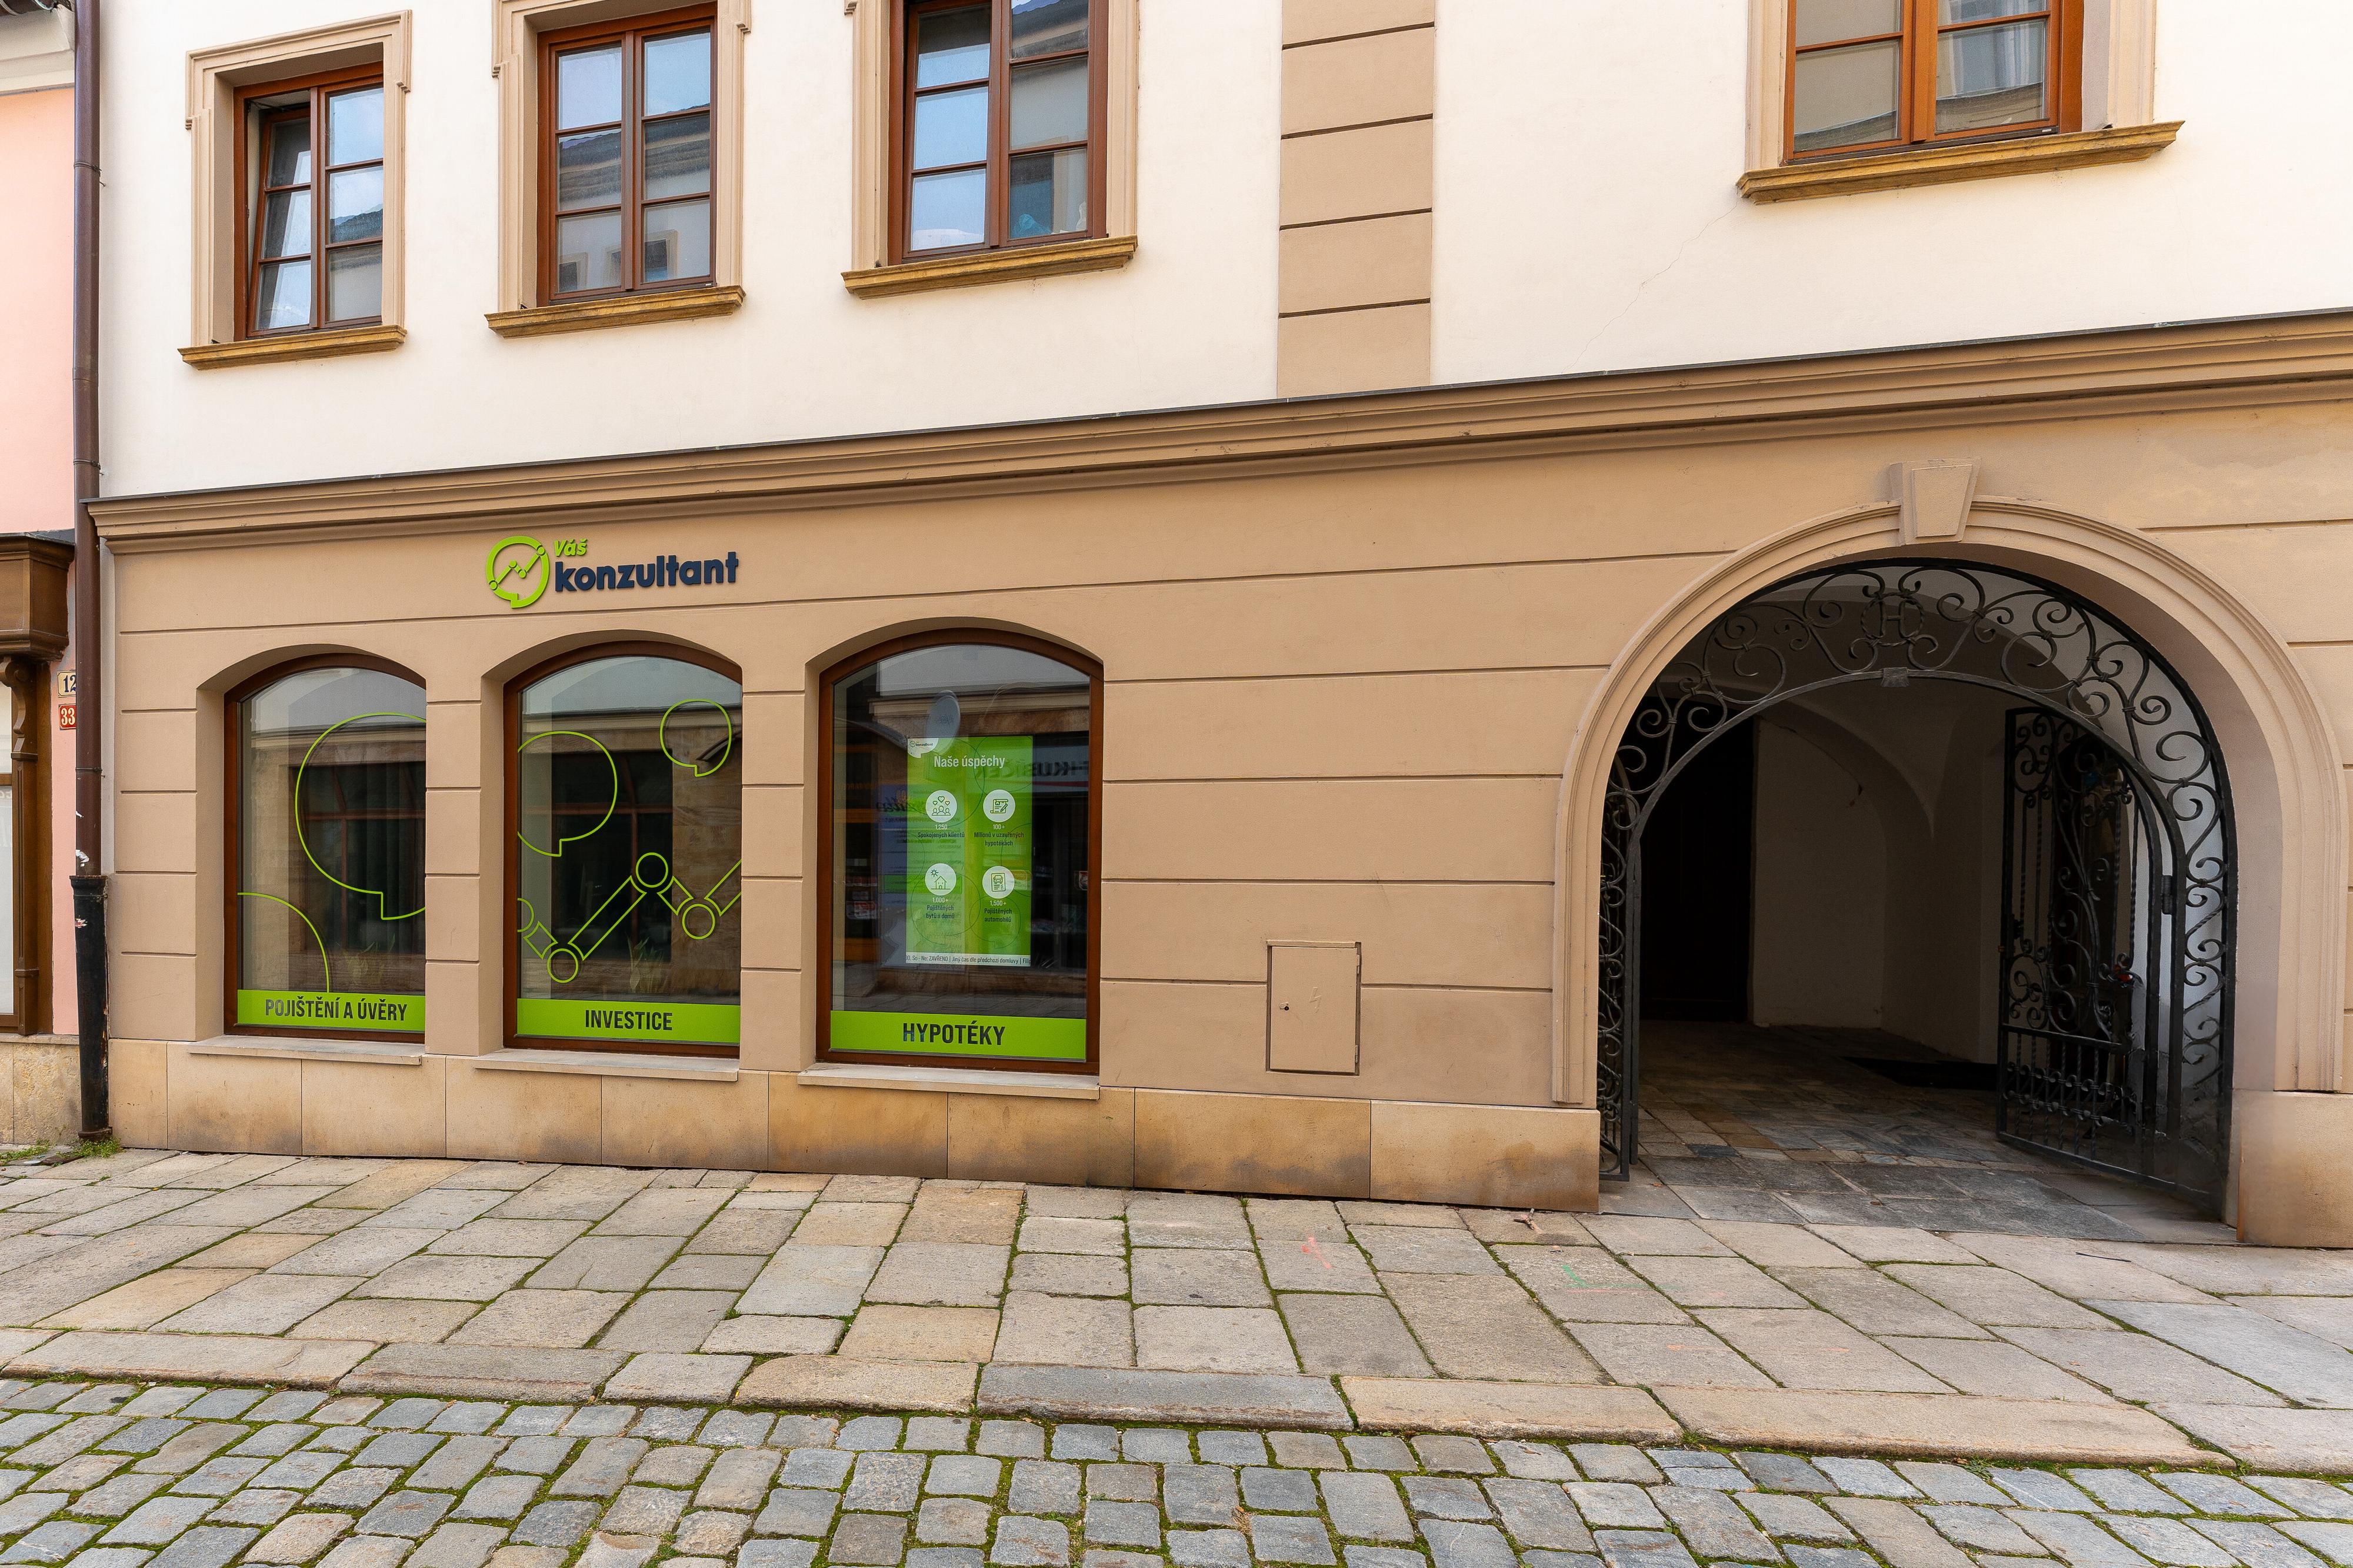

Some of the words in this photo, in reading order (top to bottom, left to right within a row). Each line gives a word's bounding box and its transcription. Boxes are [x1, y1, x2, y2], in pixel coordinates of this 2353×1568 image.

[554, 538, 588, 556] Váš
[555, 551, 739, 592] konzultant
[934, 755, 959, 768] Naše
[962, 755, 1005, 769] úspěchy
[996, 831, 1024, 839] uzavřených
[265, 996, 341, 1018] POJIŠTĚNÍ
[343, 1002, 354, 1019] A
[357, 998, 407, 1021] ÚVĚRY
[585, 1009, 673, 1030] INVESTICE
[903, 1020, 1005, 1045] HYPOTÉKY
